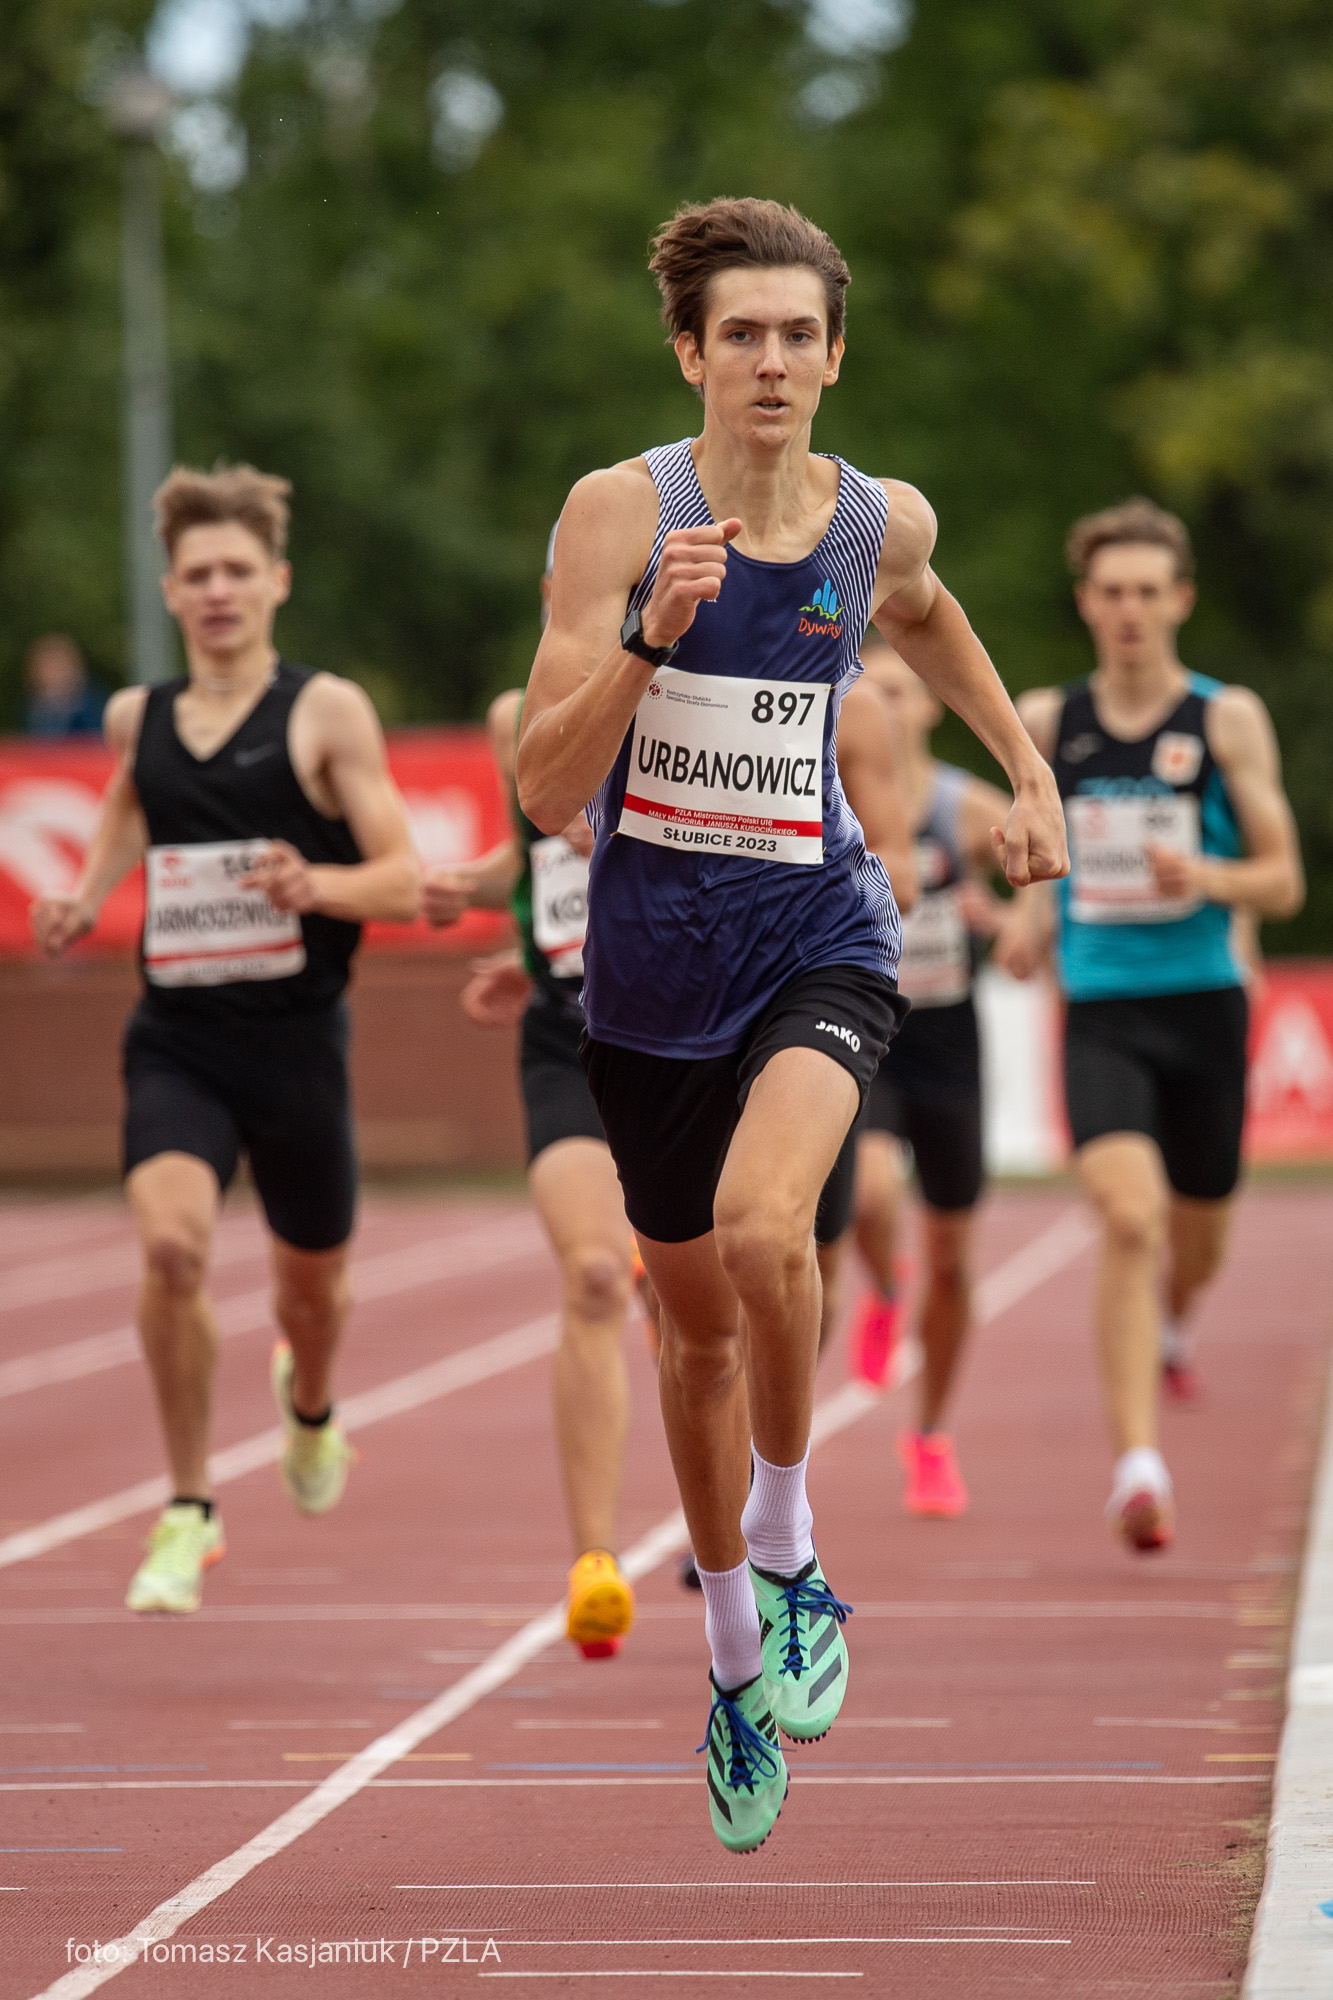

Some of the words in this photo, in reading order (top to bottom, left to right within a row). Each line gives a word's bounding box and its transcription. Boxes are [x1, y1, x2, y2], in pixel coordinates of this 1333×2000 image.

[798, 617, 842, 639] Dywity
[751, 689, 816, 726] 897
[638, 735, 817, 797] URBANOWICZ
[648, 809, 666, 820] MAŁY
[667, 813, 705, 826] MEMORIAŁ
[706, 820, 739, 830] JANUSZA
[740, 824, 798, 837] KUSOCIŃSKIEGO
[674, 808, 692, 818] PZLA
[693, 810, 737, 822] Mistrzostwa
[738, 816, 759, 826] Polski
[663, 827, 733, 847] SŁUBICE
[736, 836, 777, 853] 2023
[815, 1020, 861, 1053] JAKO
